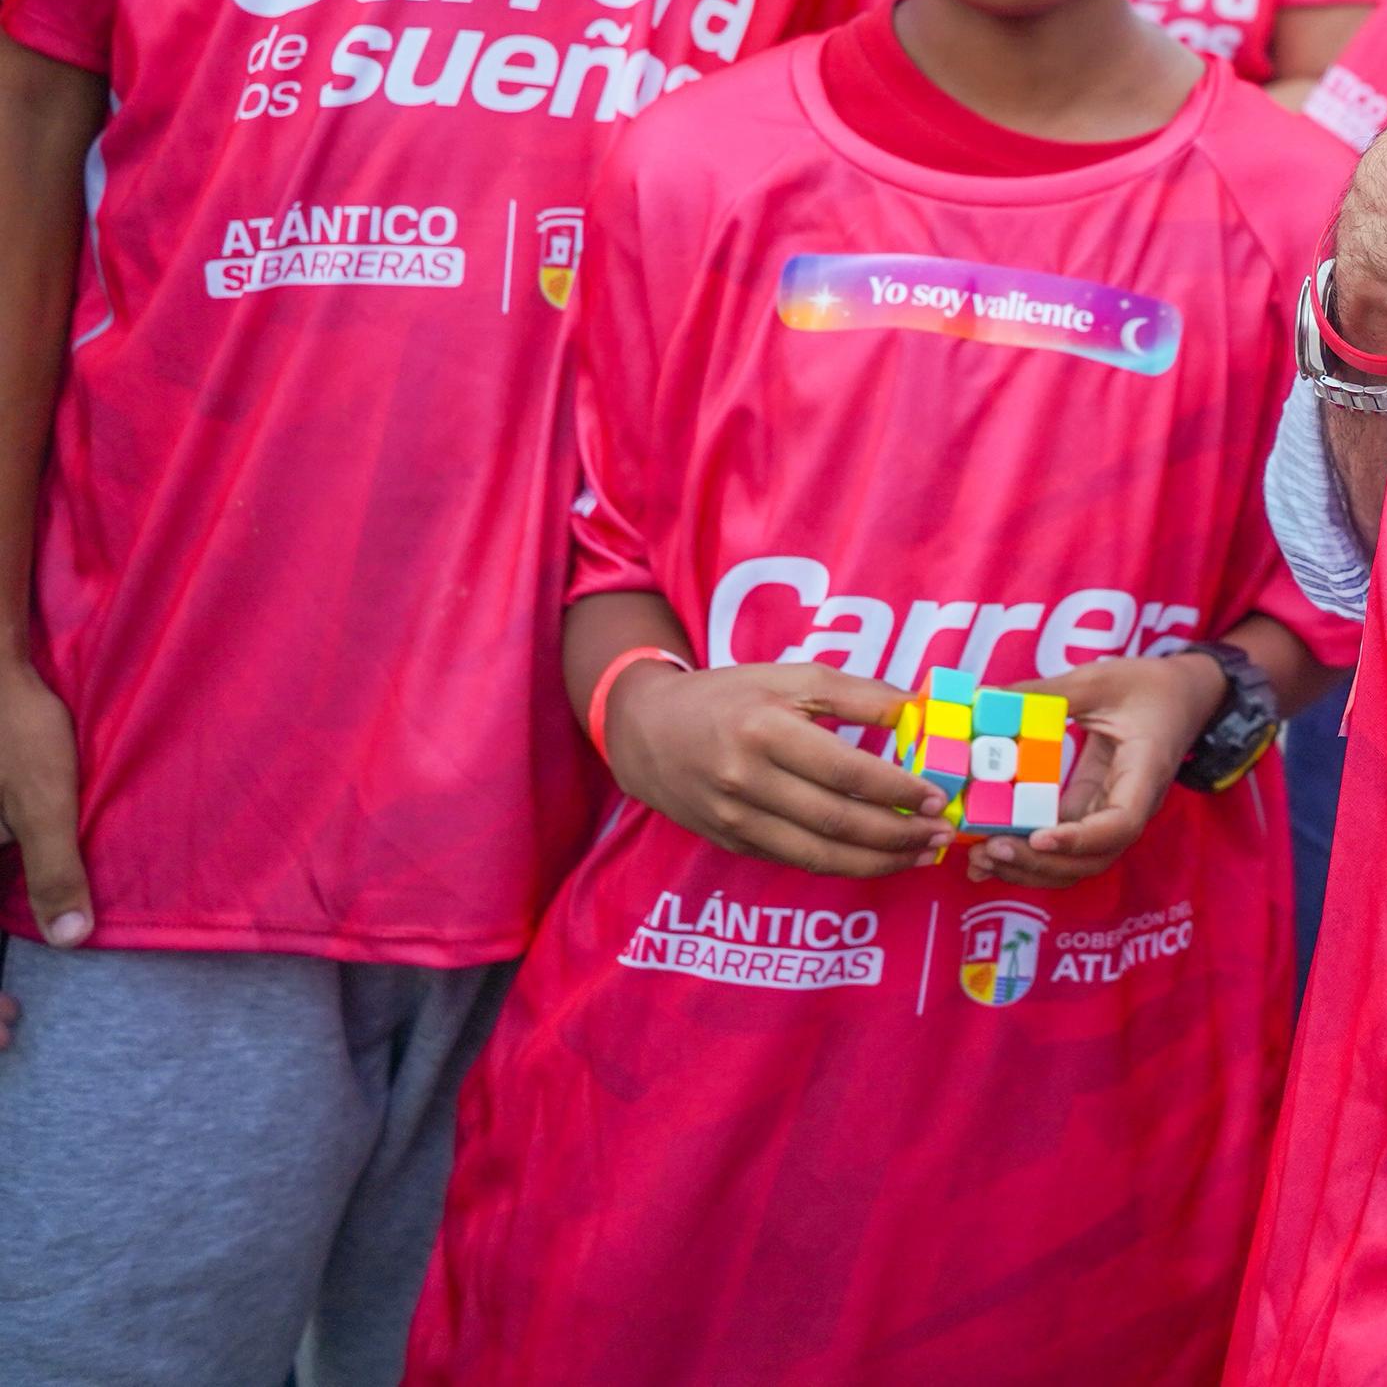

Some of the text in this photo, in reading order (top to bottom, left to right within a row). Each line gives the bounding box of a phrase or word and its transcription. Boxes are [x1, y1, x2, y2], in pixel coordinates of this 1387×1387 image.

[247, 24, 307, 73] de
[235, 75, 299, 123] os
[221, 201, 457, 257] ATLÁNTICO
[259, 250, 455, 285] BARRERAS
[869, 276, 1095, 333] Yo soy valiente
[674, 940, 874, 984] BARRERAS
